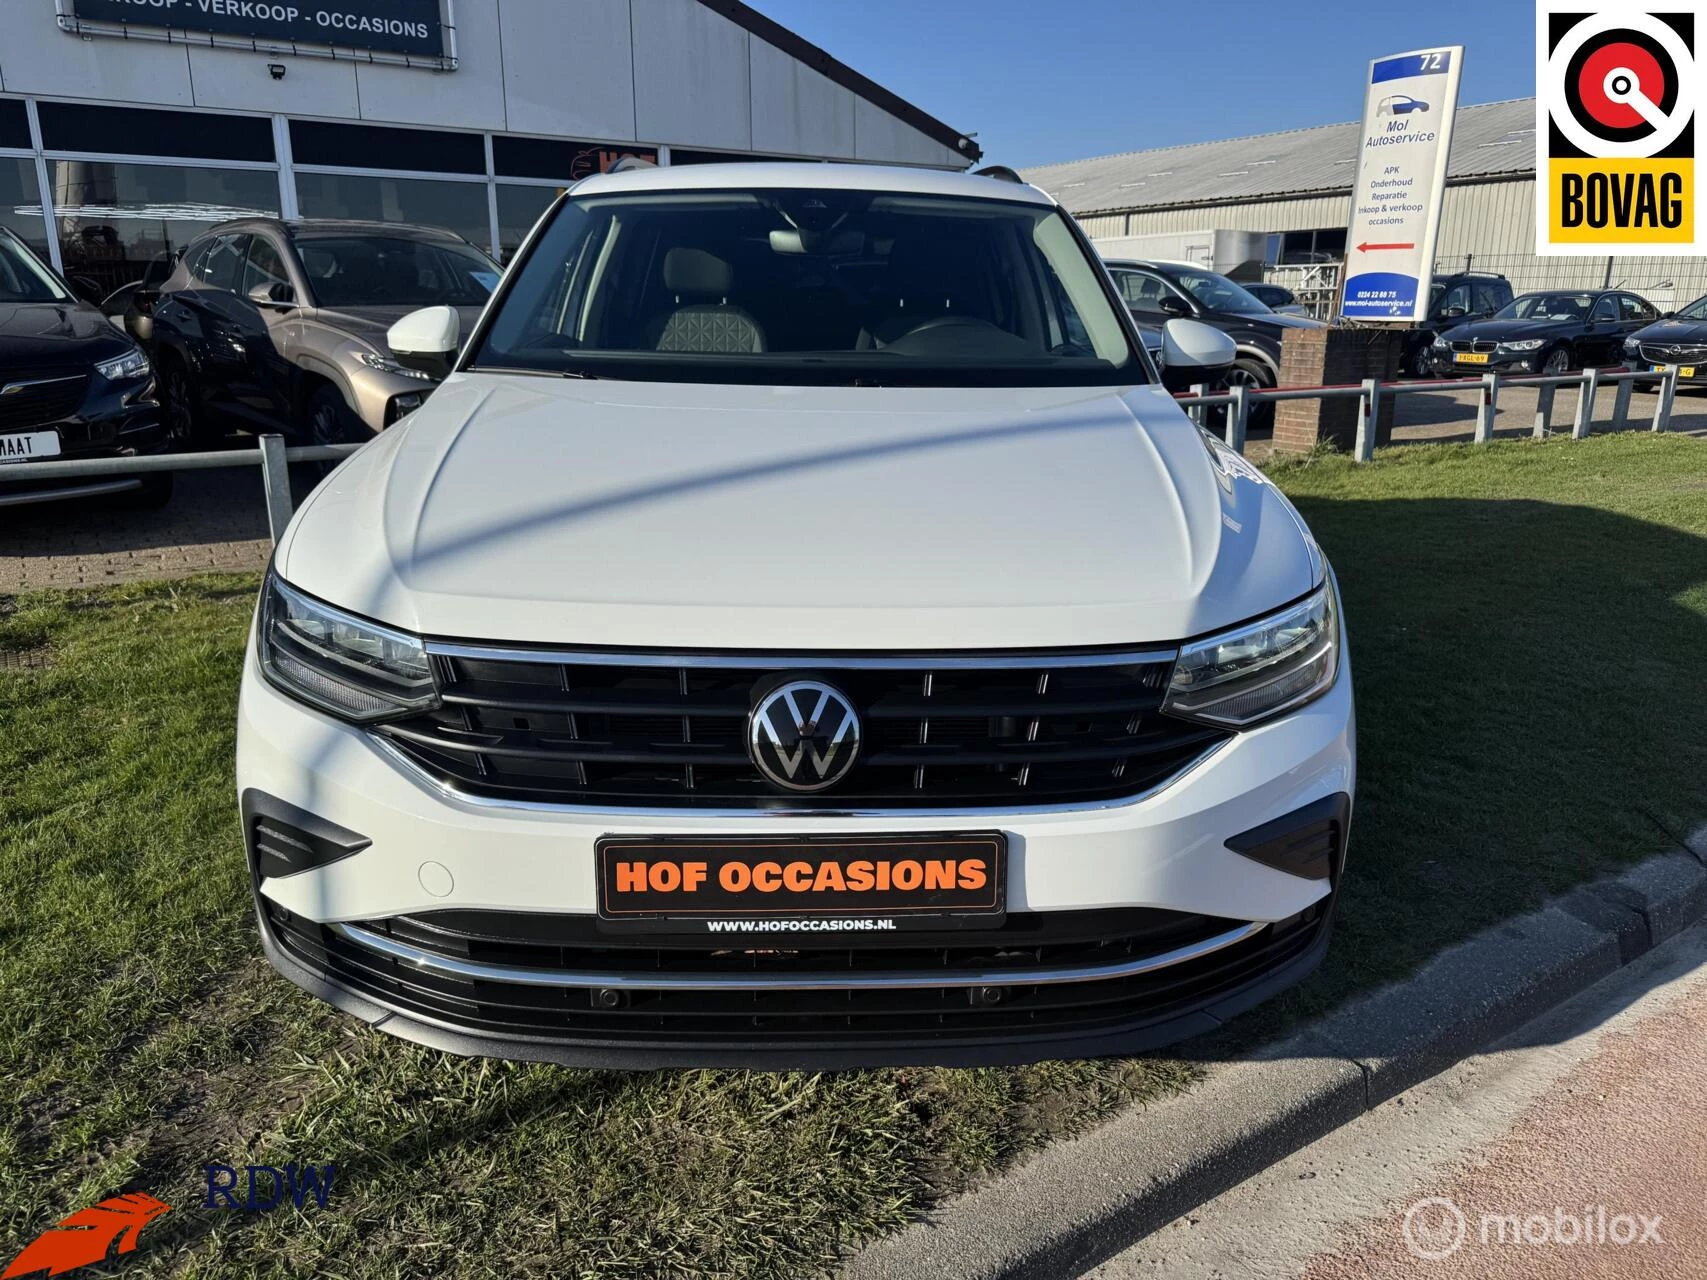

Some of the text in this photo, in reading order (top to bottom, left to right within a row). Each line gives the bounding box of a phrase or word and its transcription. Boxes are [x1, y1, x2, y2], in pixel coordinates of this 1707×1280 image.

[199, 0, 299, 23] VERKOOP
[315, 10, 429, 38] OCCASIONS
[1420, 53, 1441, 71] 72
[1386, 119, 1409, 133] Mol
[1365, 131, 1435, 148] Autoservice
[1383, 166, 1400, 175] APK
[1370, 178, 1414, 188] Onderhoud
[1371, 190, 1408, 201] Reparatie
[1358, 203, 1423, 214] Inkoop & verkoop
[1368, 216, 1404, 225] occasions
[615, 858, 988, 893] HOF OCCASIONS
[706, 919, 897, 932] WWW.HOFOCCASIONS.NL
